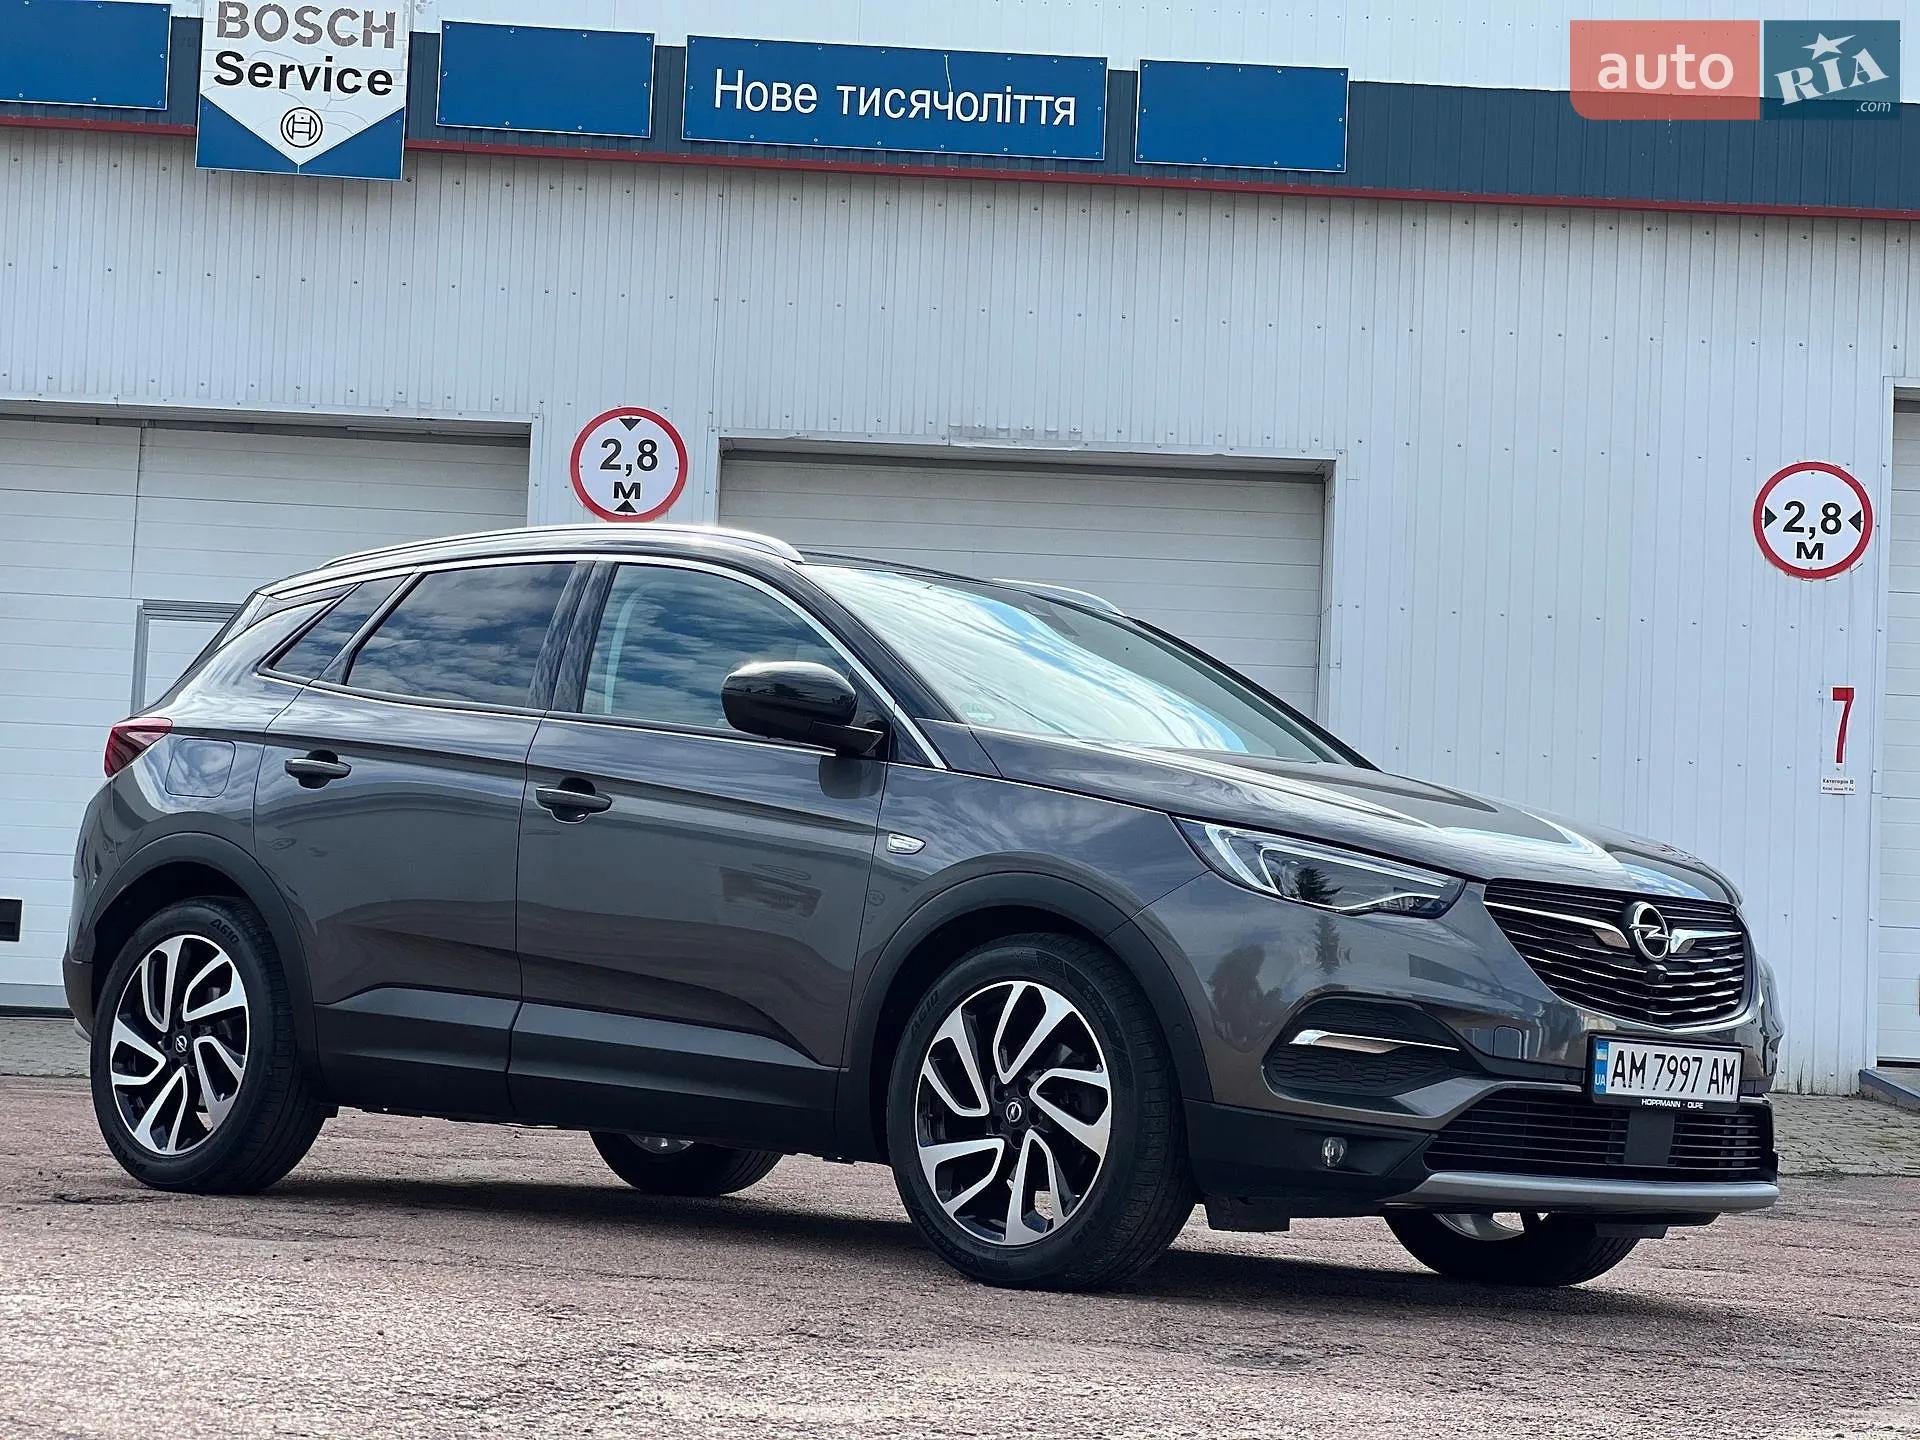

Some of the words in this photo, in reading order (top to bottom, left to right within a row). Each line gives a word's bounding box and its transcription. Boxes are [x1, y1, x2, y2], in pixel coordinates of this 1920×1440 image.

[217, 1, 396, 49] BOSCH
[213, 50, 394, 96] Service
[714, 68, 818, 114] Нове
[836, 85, 1076, 126] тисячоліття
[599, 438, 658, 477] 2,8
[1782, 500, 1842, 540] 2,8
[1832, 687, 1855, 763] 7
[1594, 1073, 1606, 1086] UA
[1610, 1050, 1647, 1090] AM
[1653, 1053, 1703, 1093] 7997
[1706, 1057, 1736, 1096] AM
